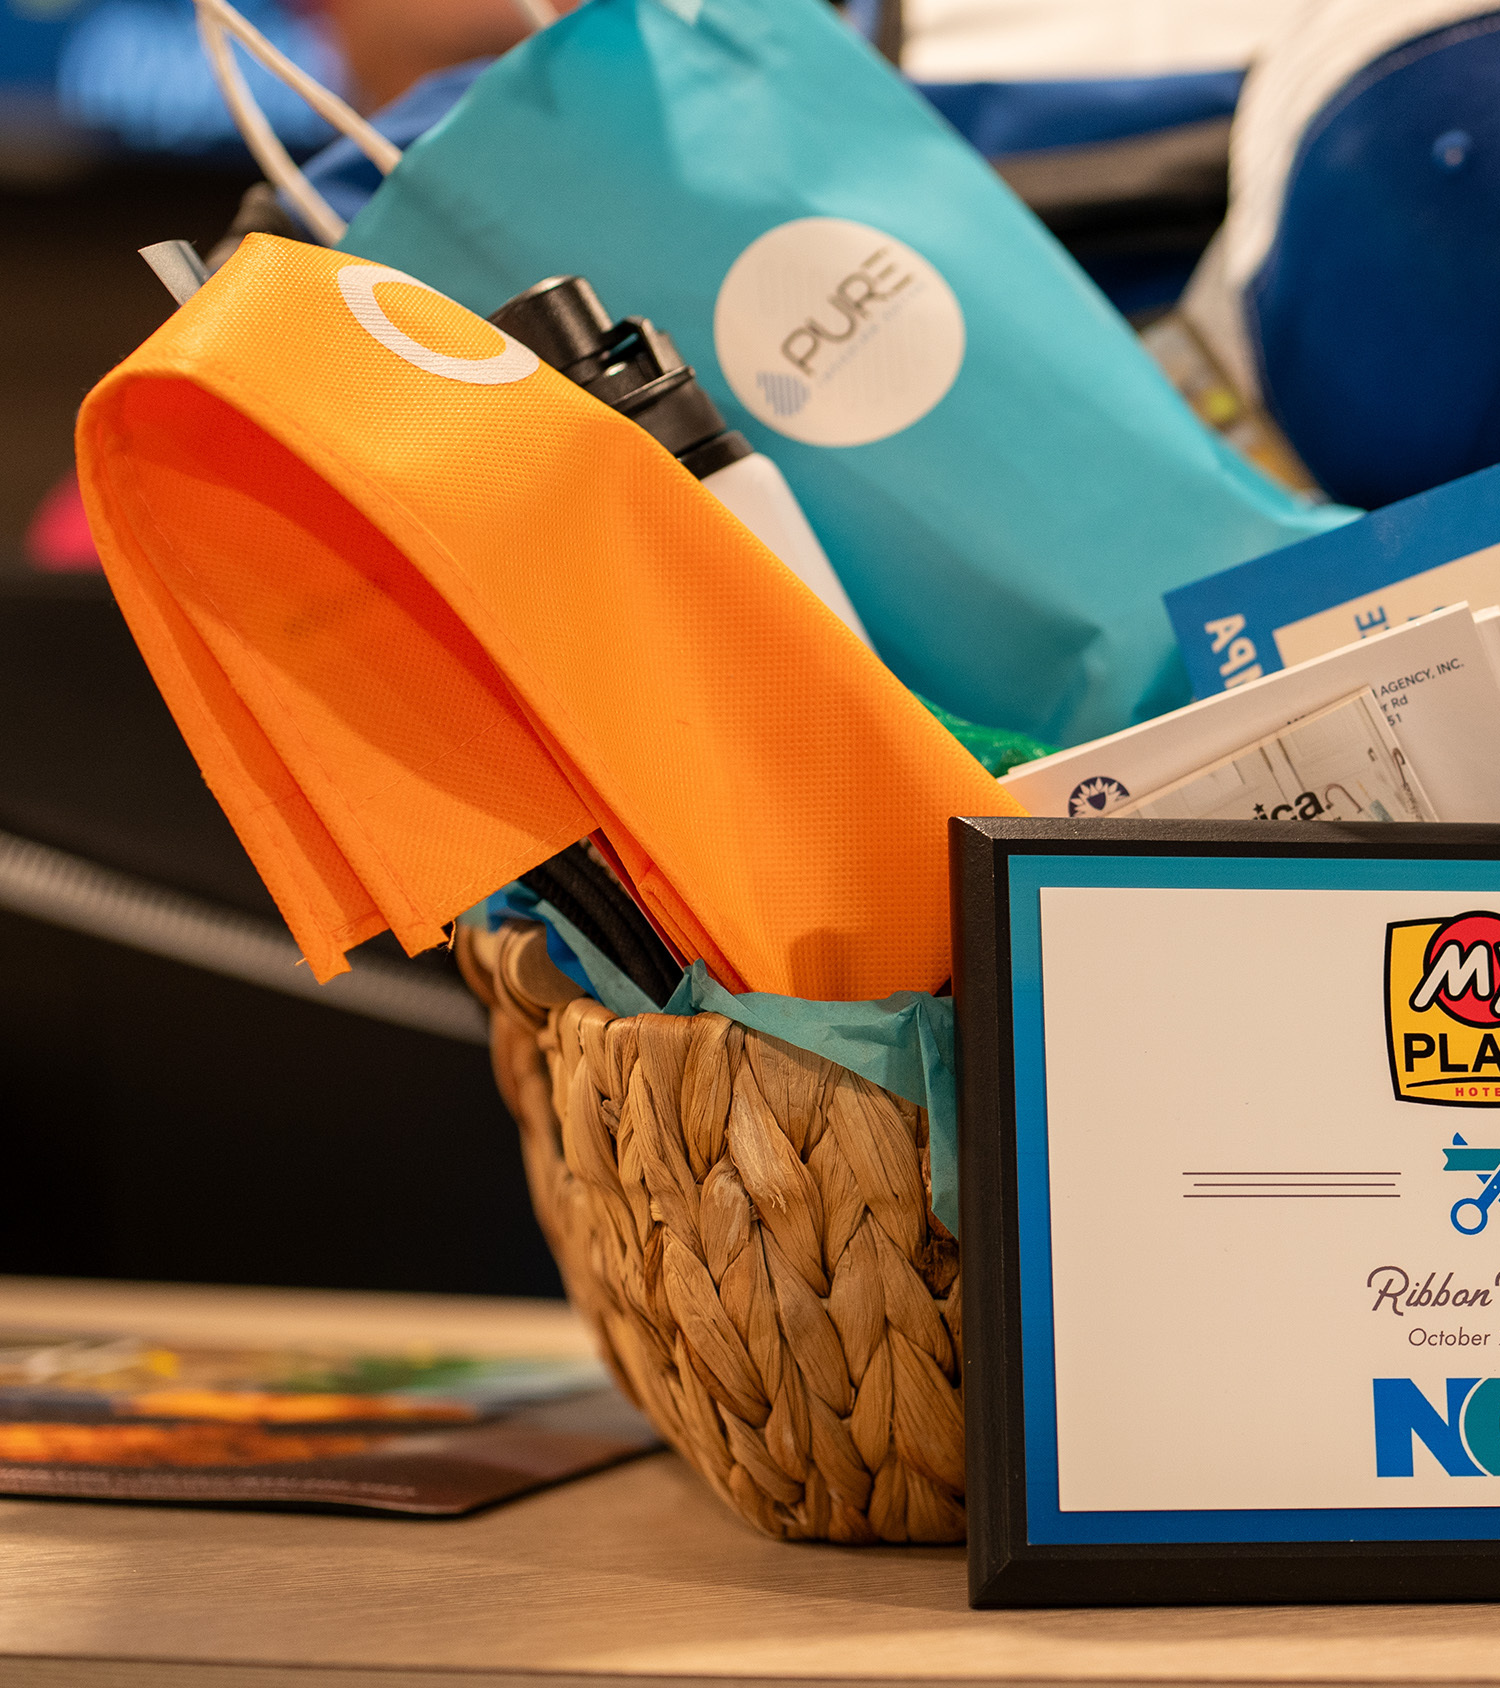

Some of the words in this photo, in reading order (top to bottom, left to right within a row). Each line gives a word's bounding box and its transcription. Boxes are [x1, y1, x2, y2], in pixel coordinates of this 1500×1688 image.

[780, 246, 915, 379] PURE
[1379, 667, 1435, 697] AGENCY,
[1436, 657, 1465, 675] INC.
[1391, 694, 1409, 709] Rd
[1366, 1265, 1493, 1317] Ribbon
[1407, 1326, 1491, 1347] October
